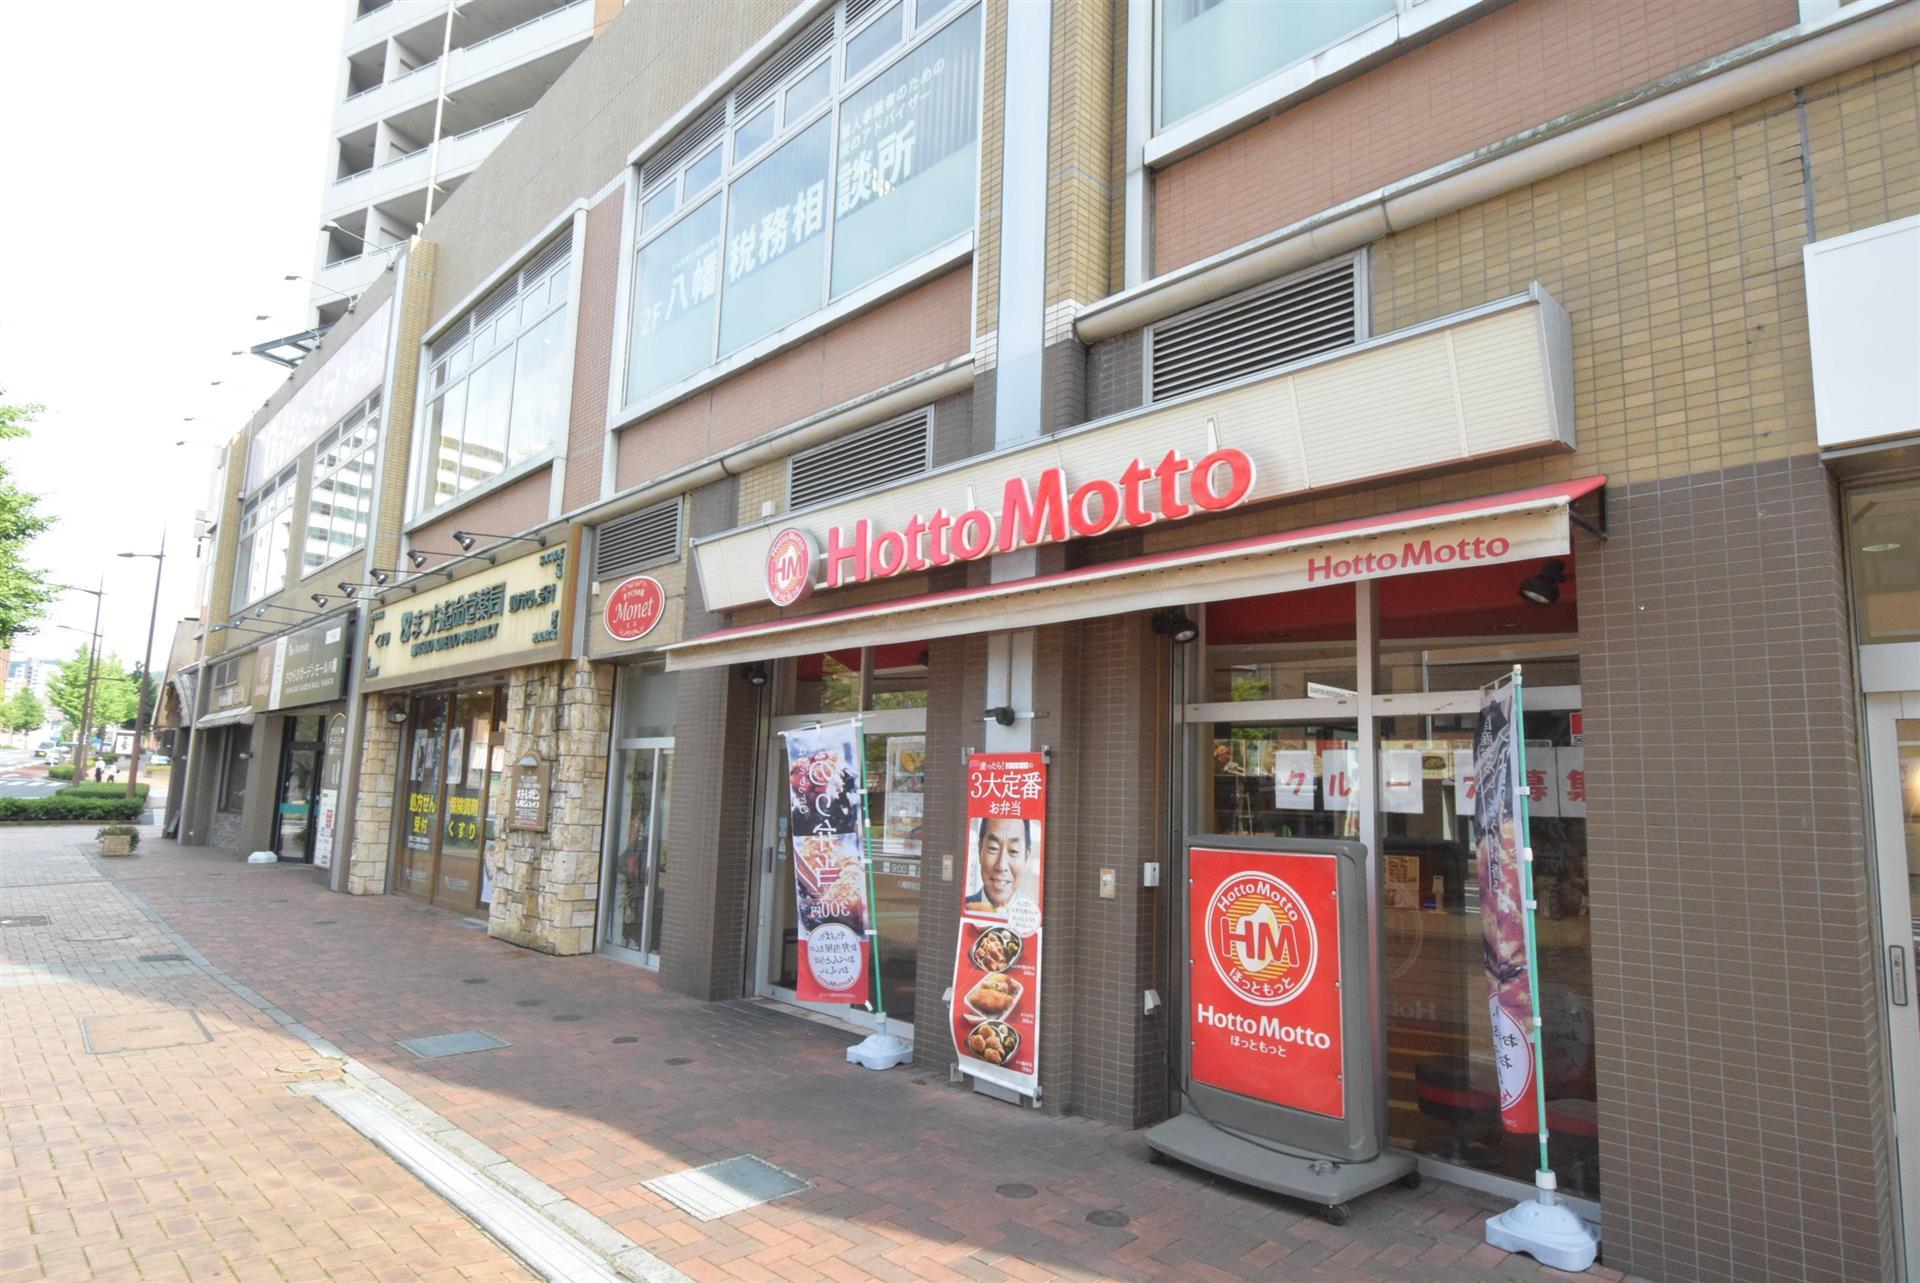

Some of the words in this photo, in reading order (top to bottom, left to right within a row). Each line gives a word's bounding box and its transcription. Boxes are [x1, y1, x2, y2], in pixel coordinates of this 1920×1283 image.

[613, 597, 653, 623] Monet
[971, 771, 1042, 800] 3大定番
[409, 791, 437, 814] 処方せん
[989, 801, 1021, 816] お弁当
[413, 816, 428, 834] 受付
[448, 819, 477, 840] くすり
[1229, 967, 1294, 997] ほっともっと
[1230, 1035, 1287, 1058] ほっともっと
